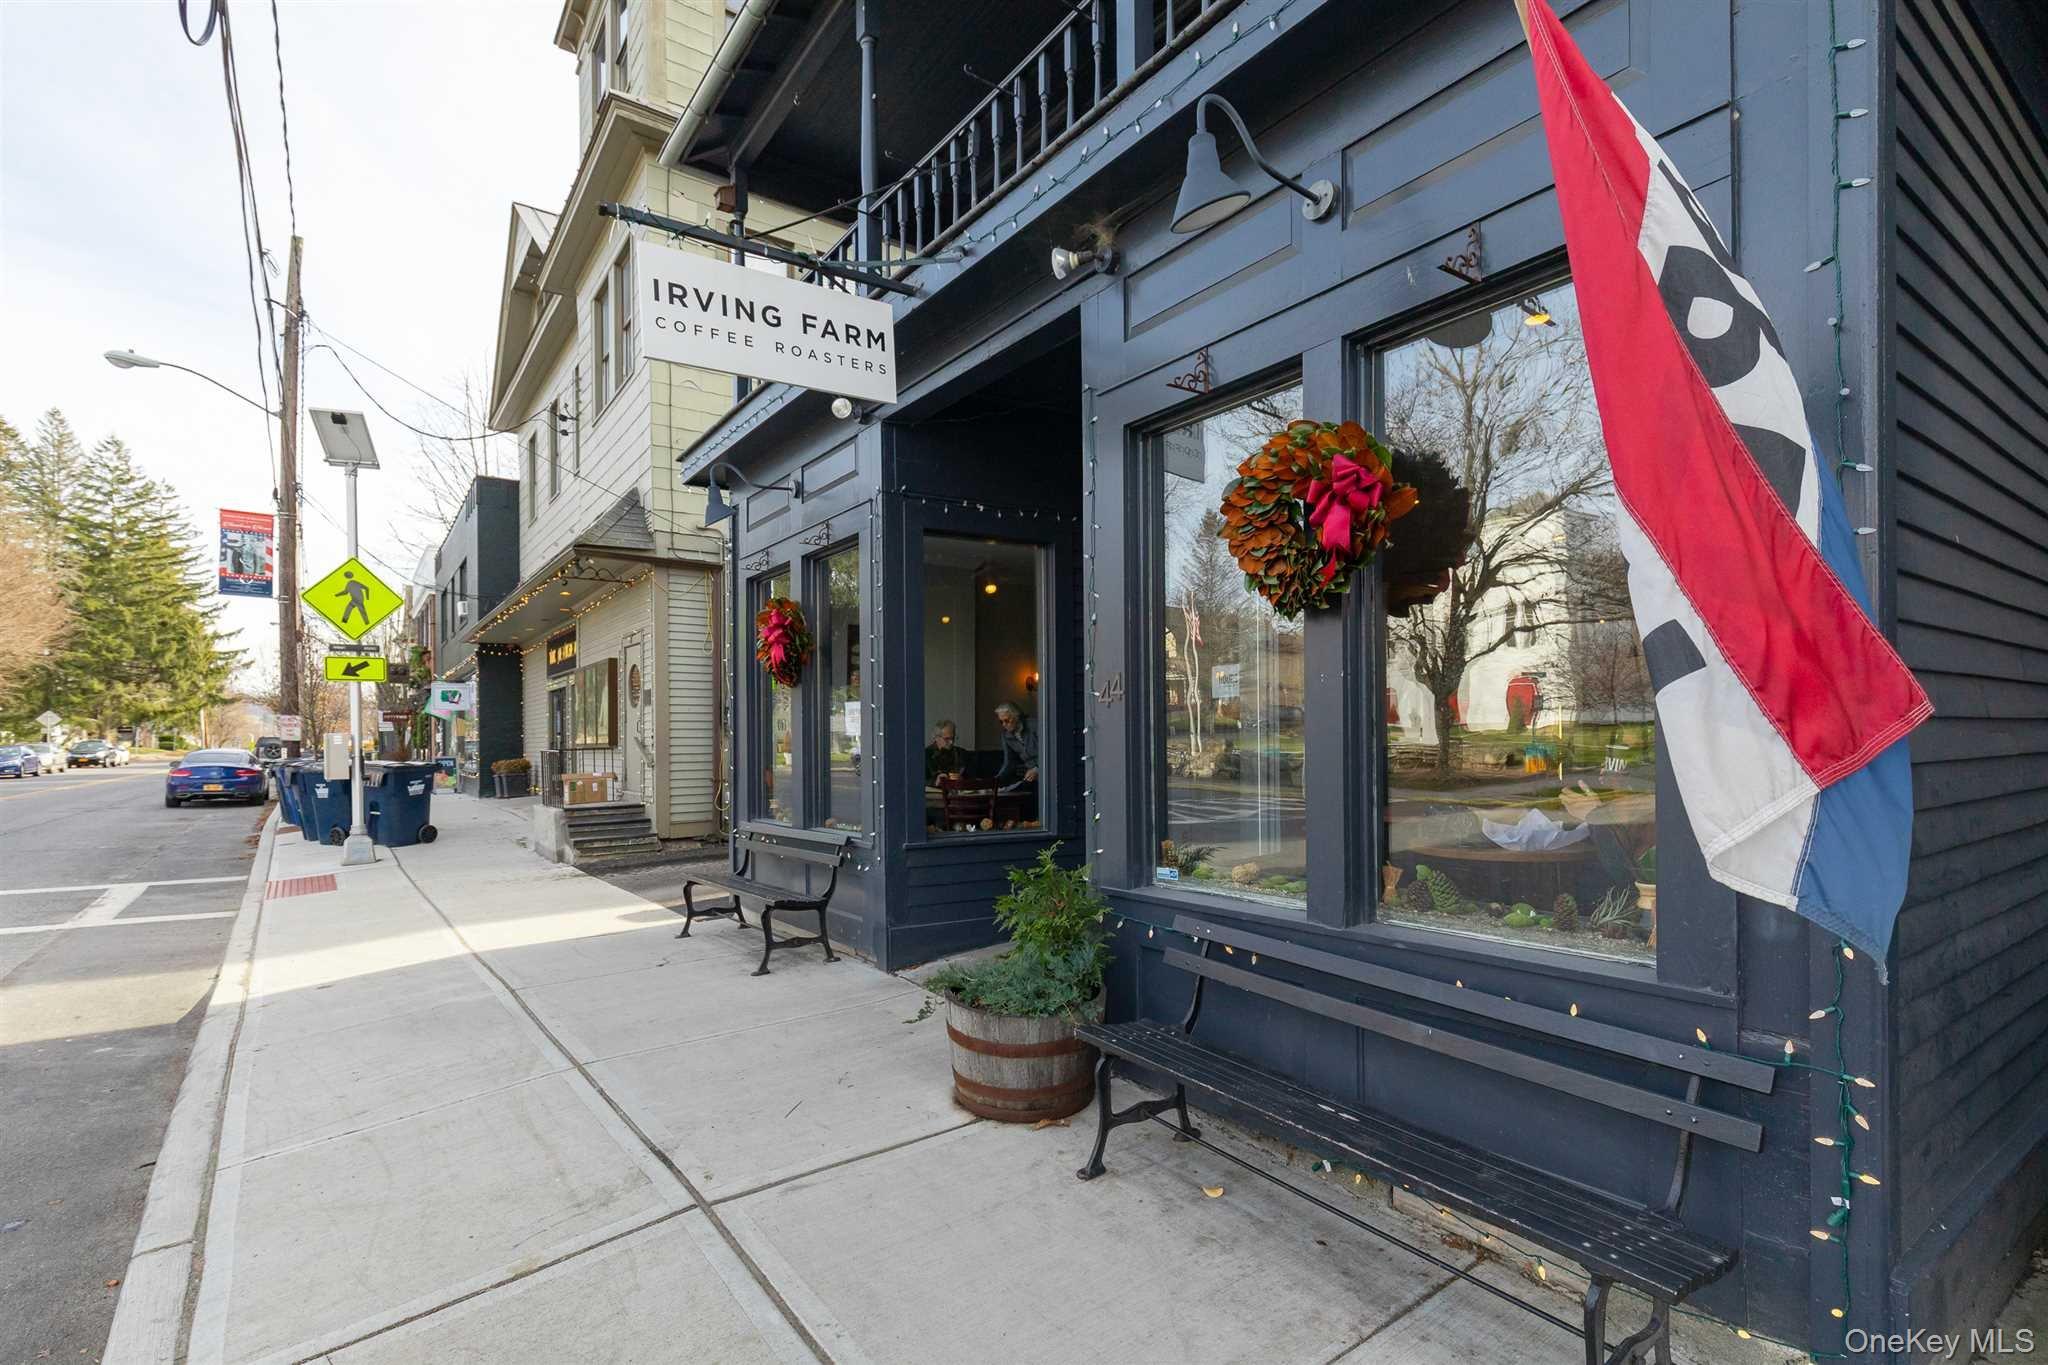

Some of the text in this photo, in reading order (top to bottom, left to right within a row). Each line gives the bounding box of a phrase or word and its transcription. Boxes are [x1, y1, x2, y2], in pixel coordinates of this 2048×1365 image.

[652, 278, 886, 352] IRVING FARM
[655, 316, 887, 375] COFFEE ROASTERS
[1097, 672, 1125, 709] 44
